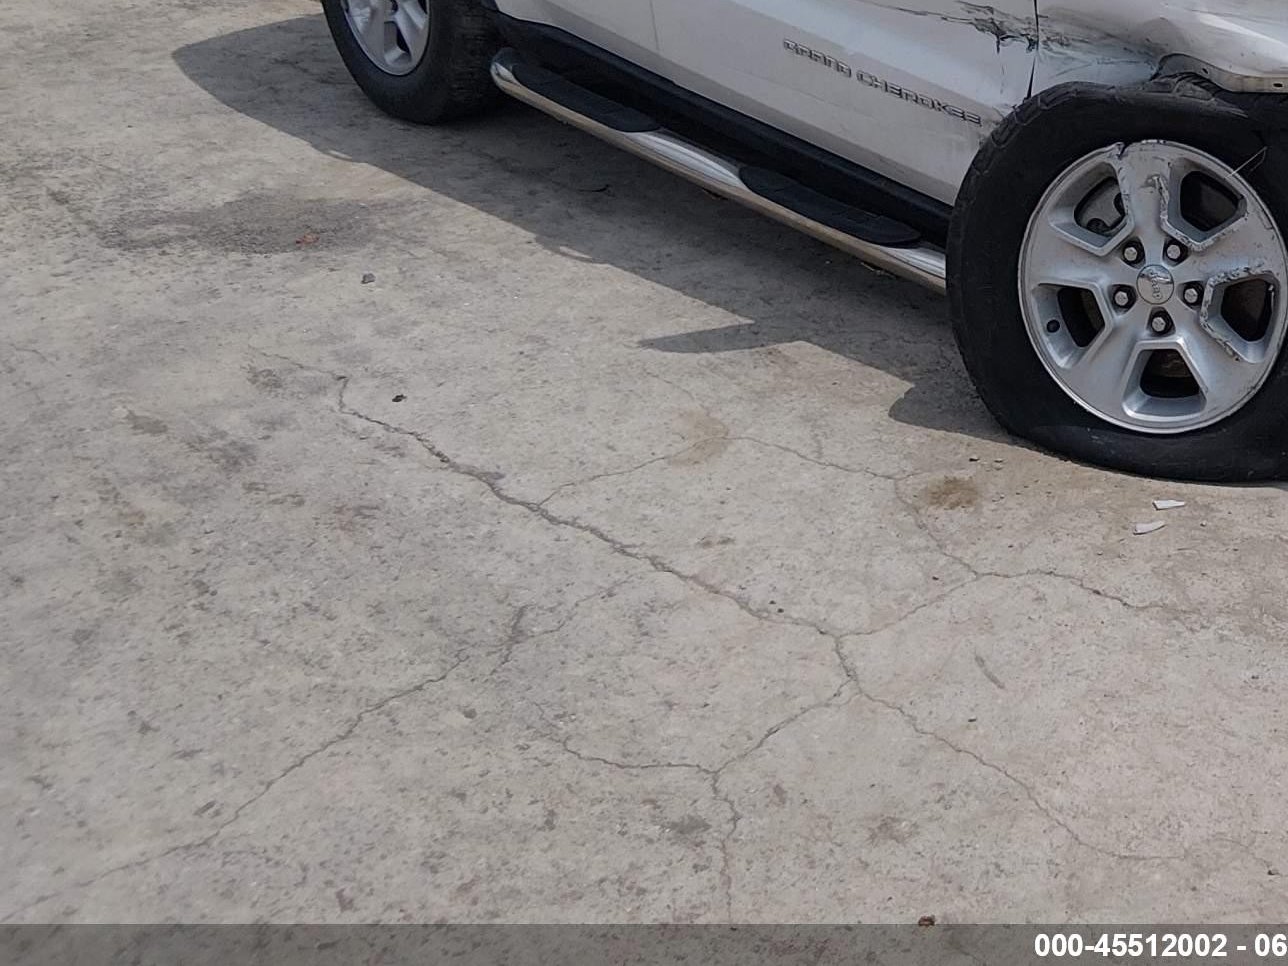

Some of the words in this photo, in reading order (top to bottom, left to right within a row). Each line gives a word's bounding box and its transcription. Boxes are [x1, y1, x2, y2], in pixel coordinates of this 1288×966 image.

[782, 37, 852, 79] GRAND
[856, 69, 983, 127] CHEROKEE
[1148, 269, 1170, 300] Jeep
